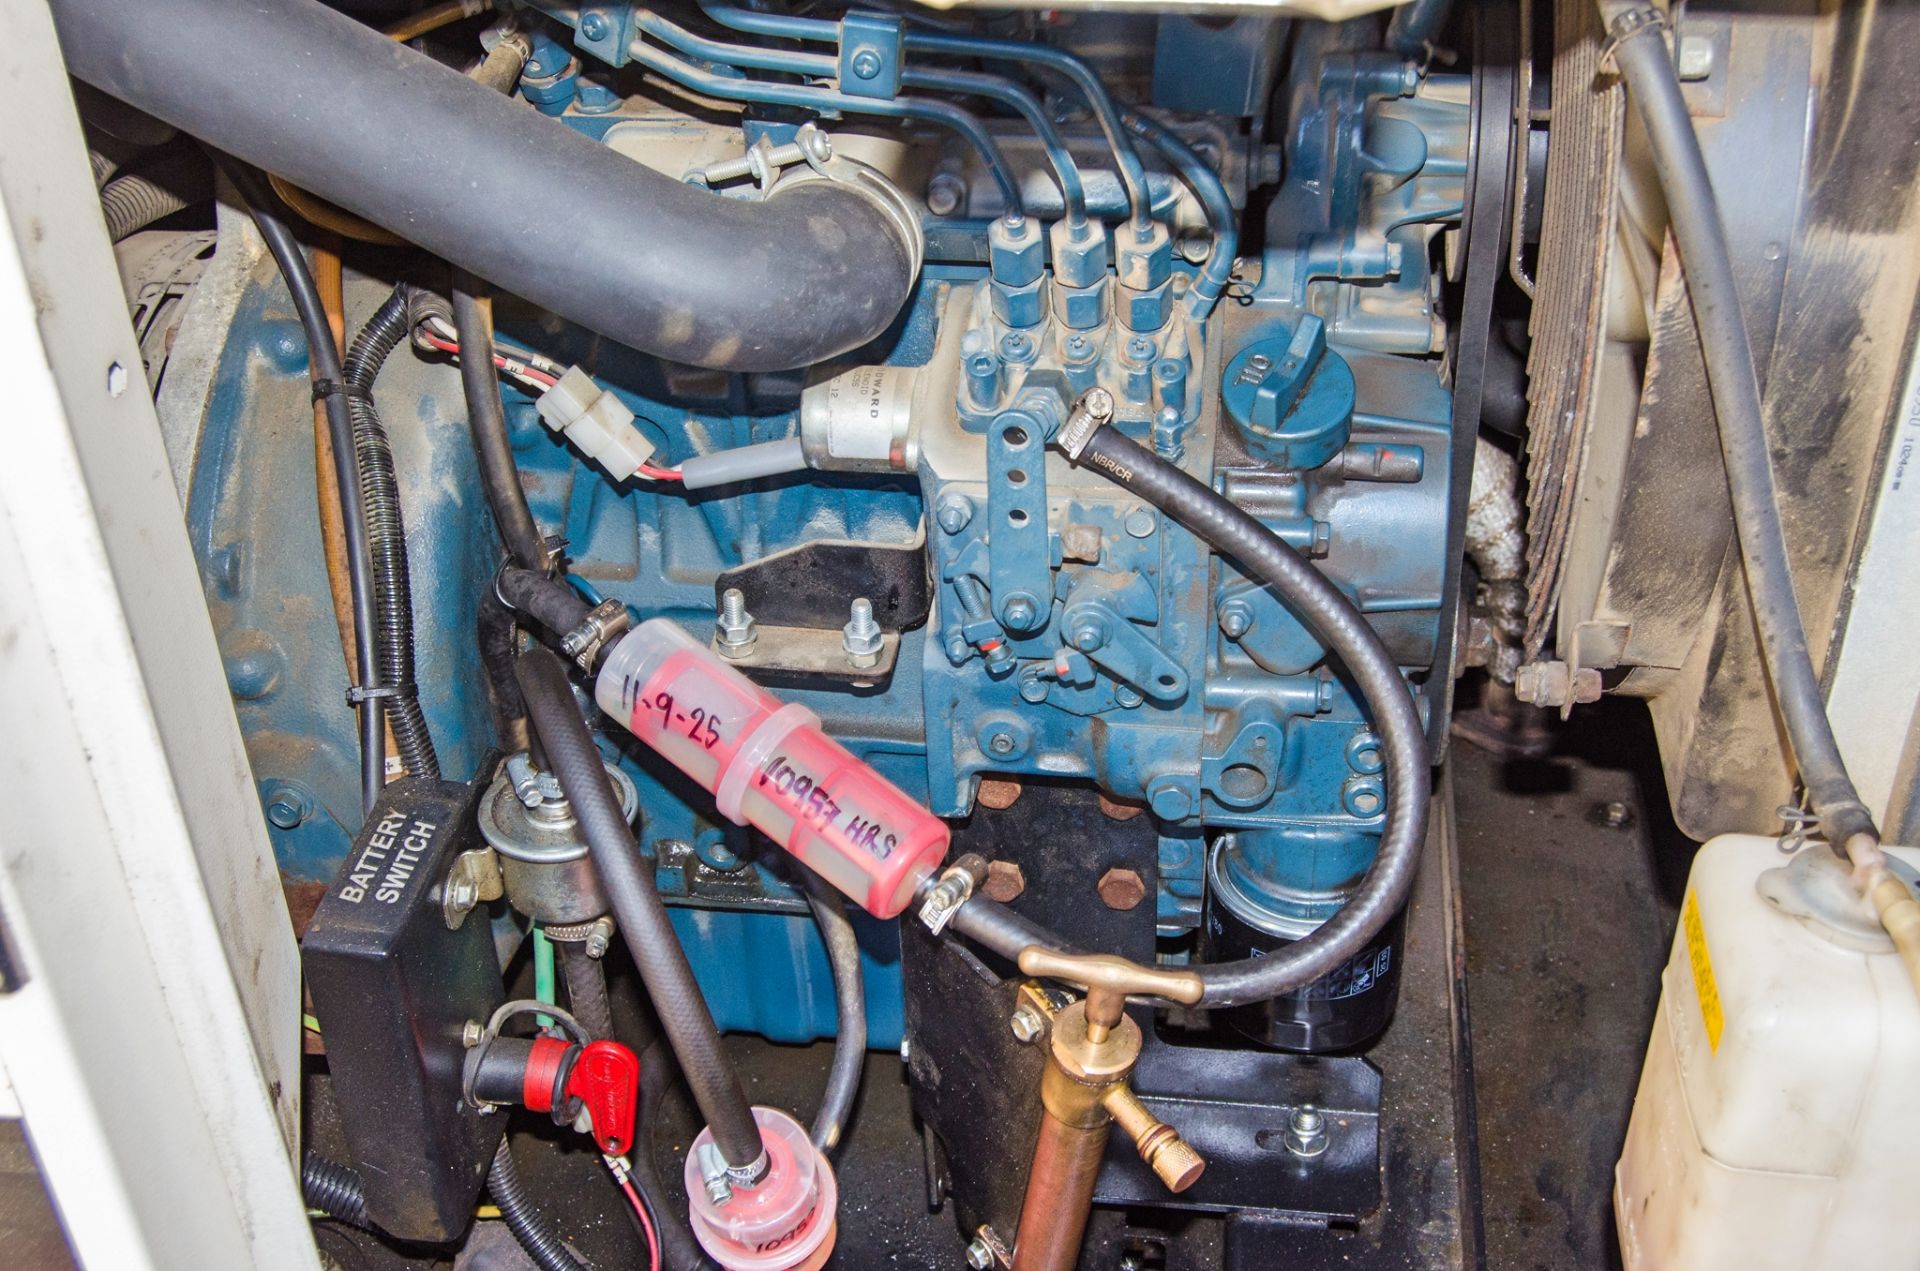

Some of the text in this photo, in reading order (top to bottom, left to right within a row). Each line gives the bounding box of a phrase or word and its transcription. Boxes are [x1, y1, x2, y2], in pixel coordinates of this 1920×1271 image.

[1233, 354, 1271, 386] OIL
[1090, 451, 1133, 482] NBR/CR
[622, 674, 722, 750] 11-9-25
[338, 806, 408, 904] BATTERY
[375, 821, 437, 904] SWITCH
[844, 815, 897, 860] HRS
